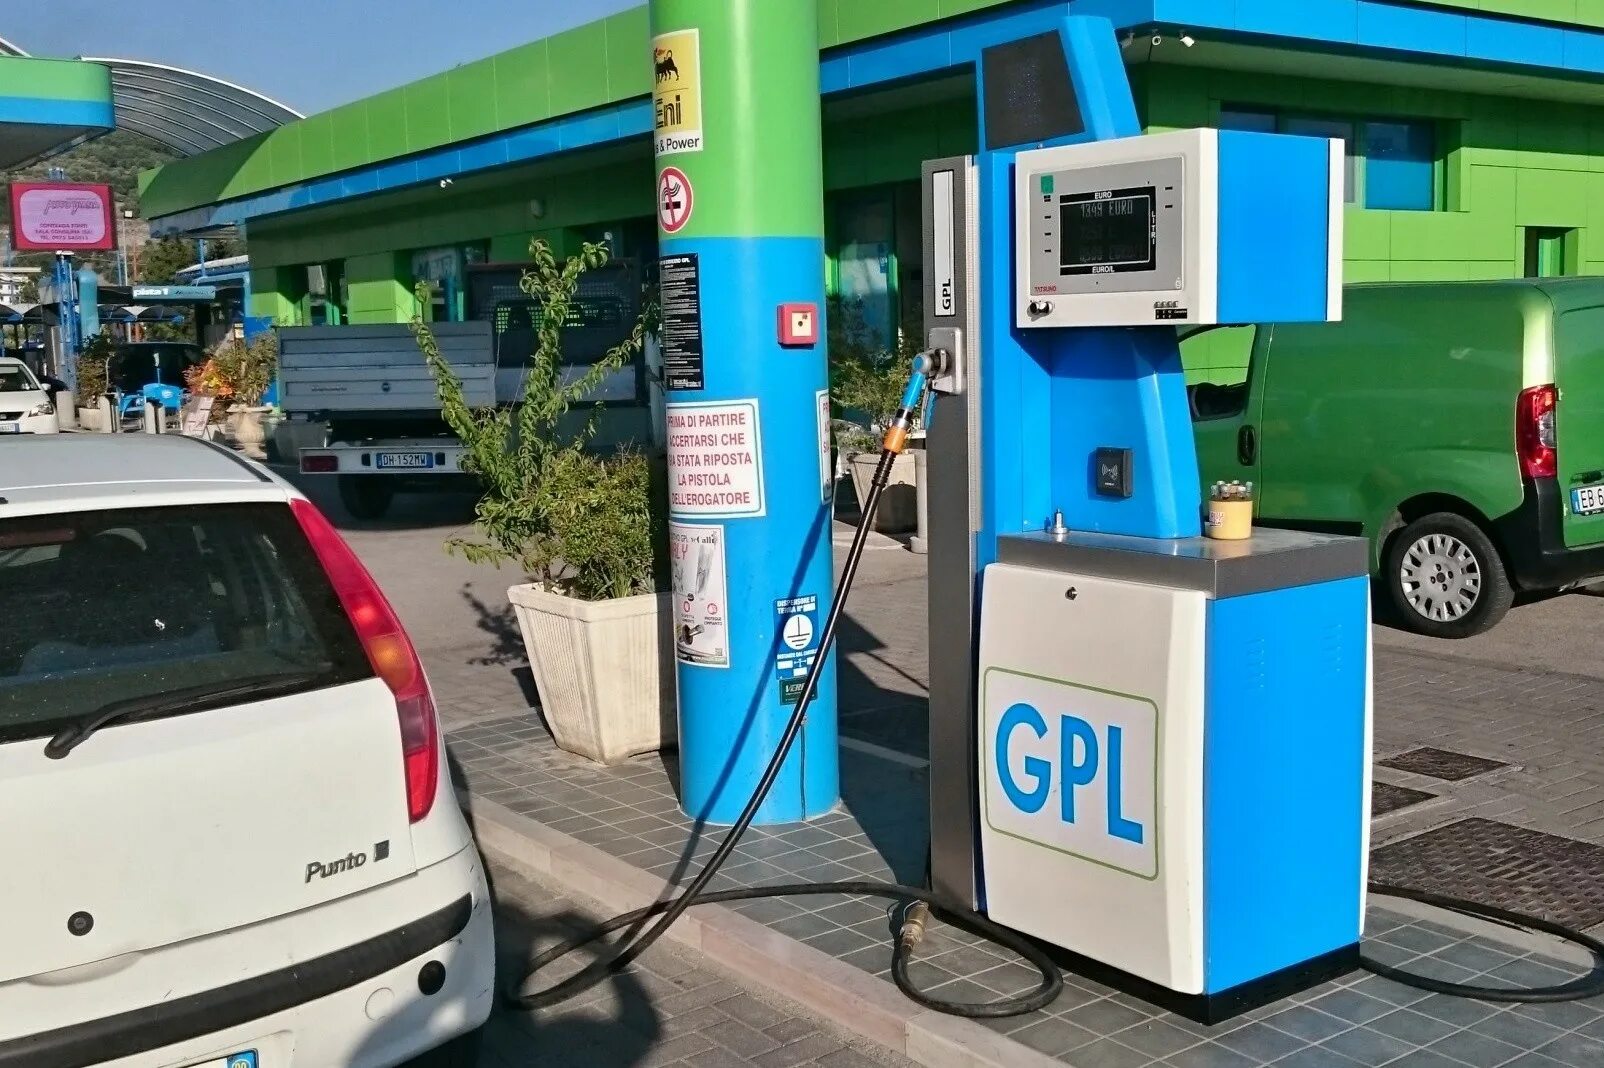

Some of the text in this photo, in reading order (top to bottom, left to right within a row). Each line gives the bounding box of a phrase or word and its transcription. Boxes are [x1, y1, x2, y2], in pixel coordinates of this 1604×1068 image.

[660, 139, 665, 152] &
[666, 138, 700, 151] Power
[1094, 192, 1112, 200] EURO
[942, 278, 951, 310] GPL
[688, 416, 696, 428] DI
[699, 412, 746, 426] PARTIRE
[721, 432, 745, 446] CHE
[676, 454, 701, 466] STATA
[704, 452, 752, 466] RIPOSTA
[678, 474, 731, 486] LA PISTOLA
[1580, 490, 1594, 508] EB
[994, 702, 1144, 844] GPL
[305, 852, 366, 884] Punto
